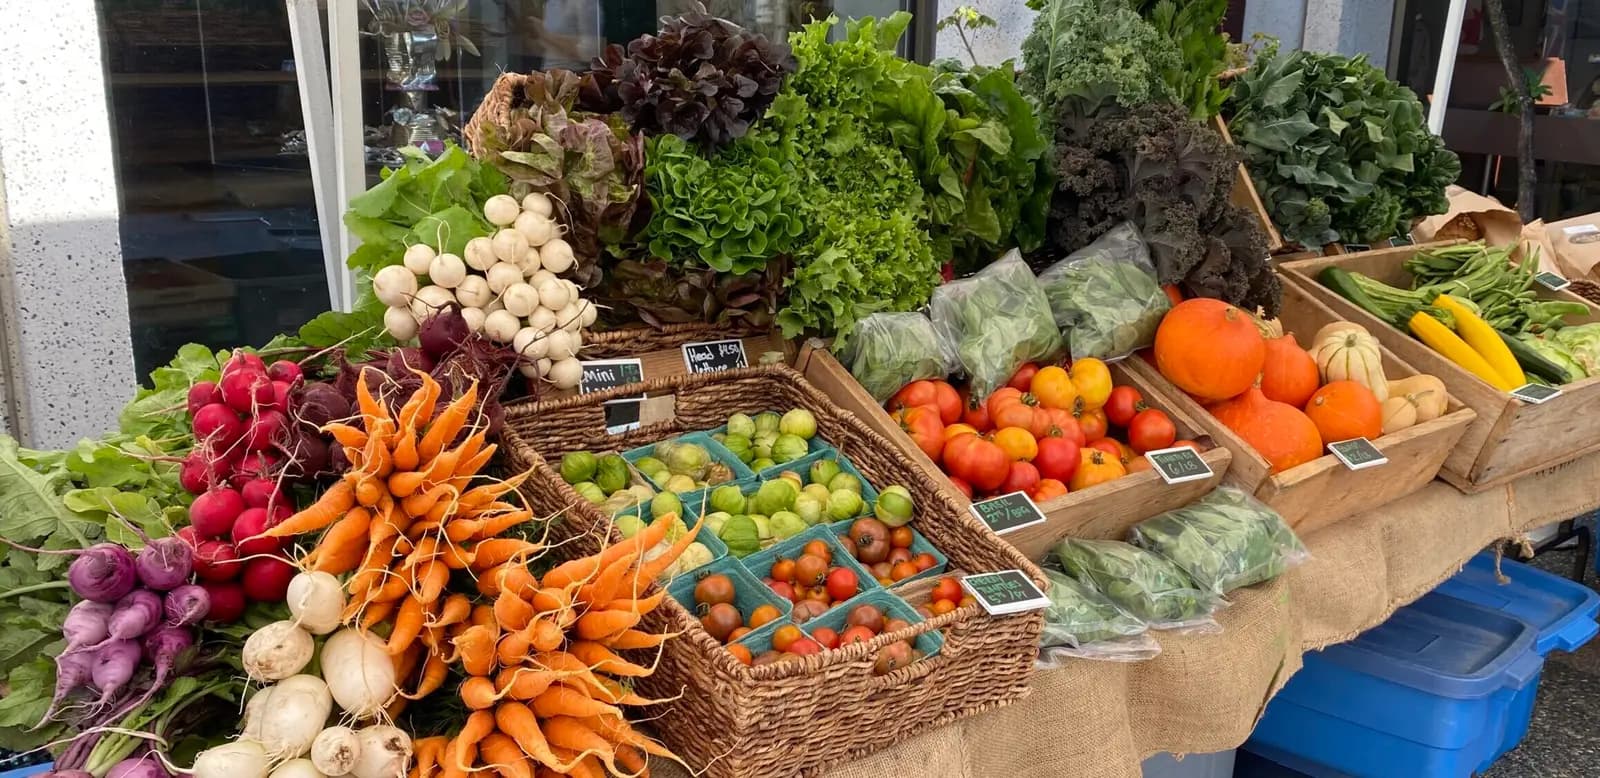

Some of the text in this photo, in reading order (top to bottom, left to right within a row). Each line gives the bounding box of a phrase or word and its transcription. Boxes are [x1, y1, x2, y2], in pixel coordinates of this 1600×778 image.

[687, 345, 715, 363] Head
[583, 368, 616, 383] Mini
[979, 499, 1013, 514] BASIL
